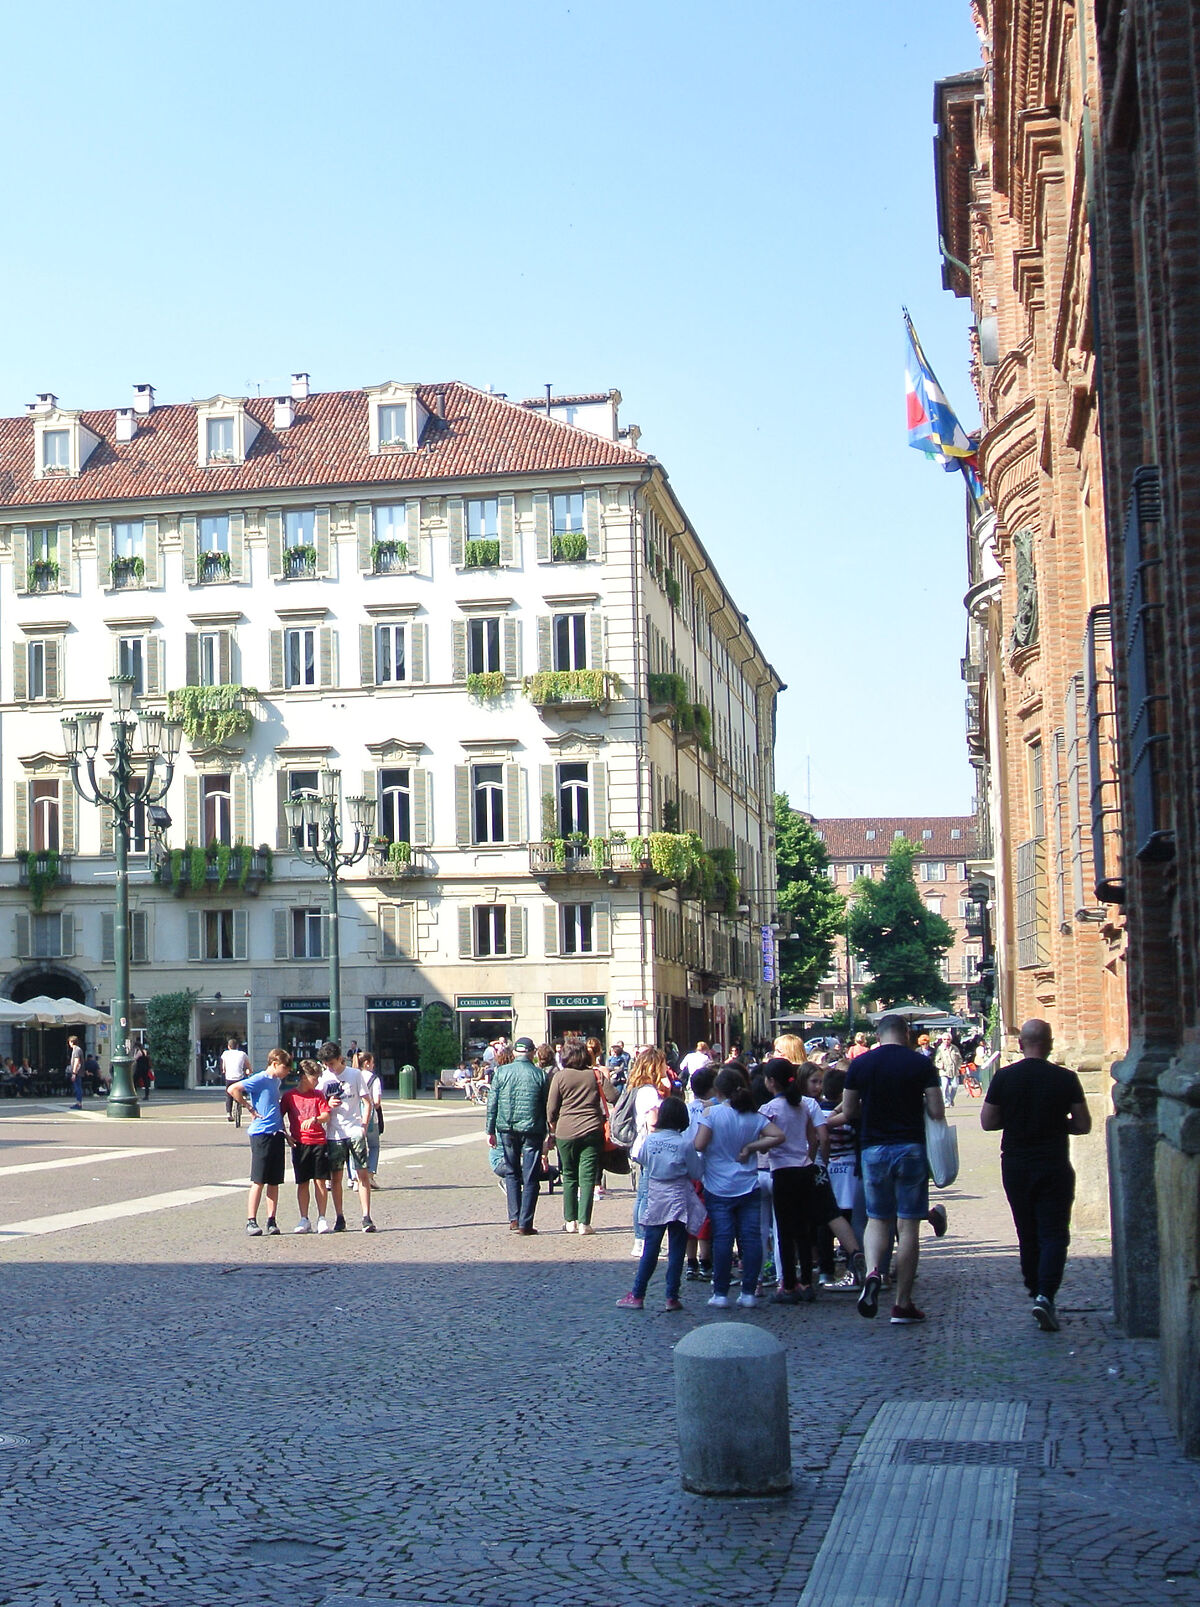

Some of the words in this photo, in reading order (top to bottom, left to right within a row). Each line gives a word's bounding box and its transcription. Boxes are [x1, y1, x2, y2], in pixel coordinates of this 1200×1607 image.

[374, 999, 383, 1007] DE
[384, 999, 407, 1007] CARLO
[555, 997, 565, 1005] DE
[566, 997, 590, 1005] CARLO
[830, 1166, 848, 1174] LOSE
